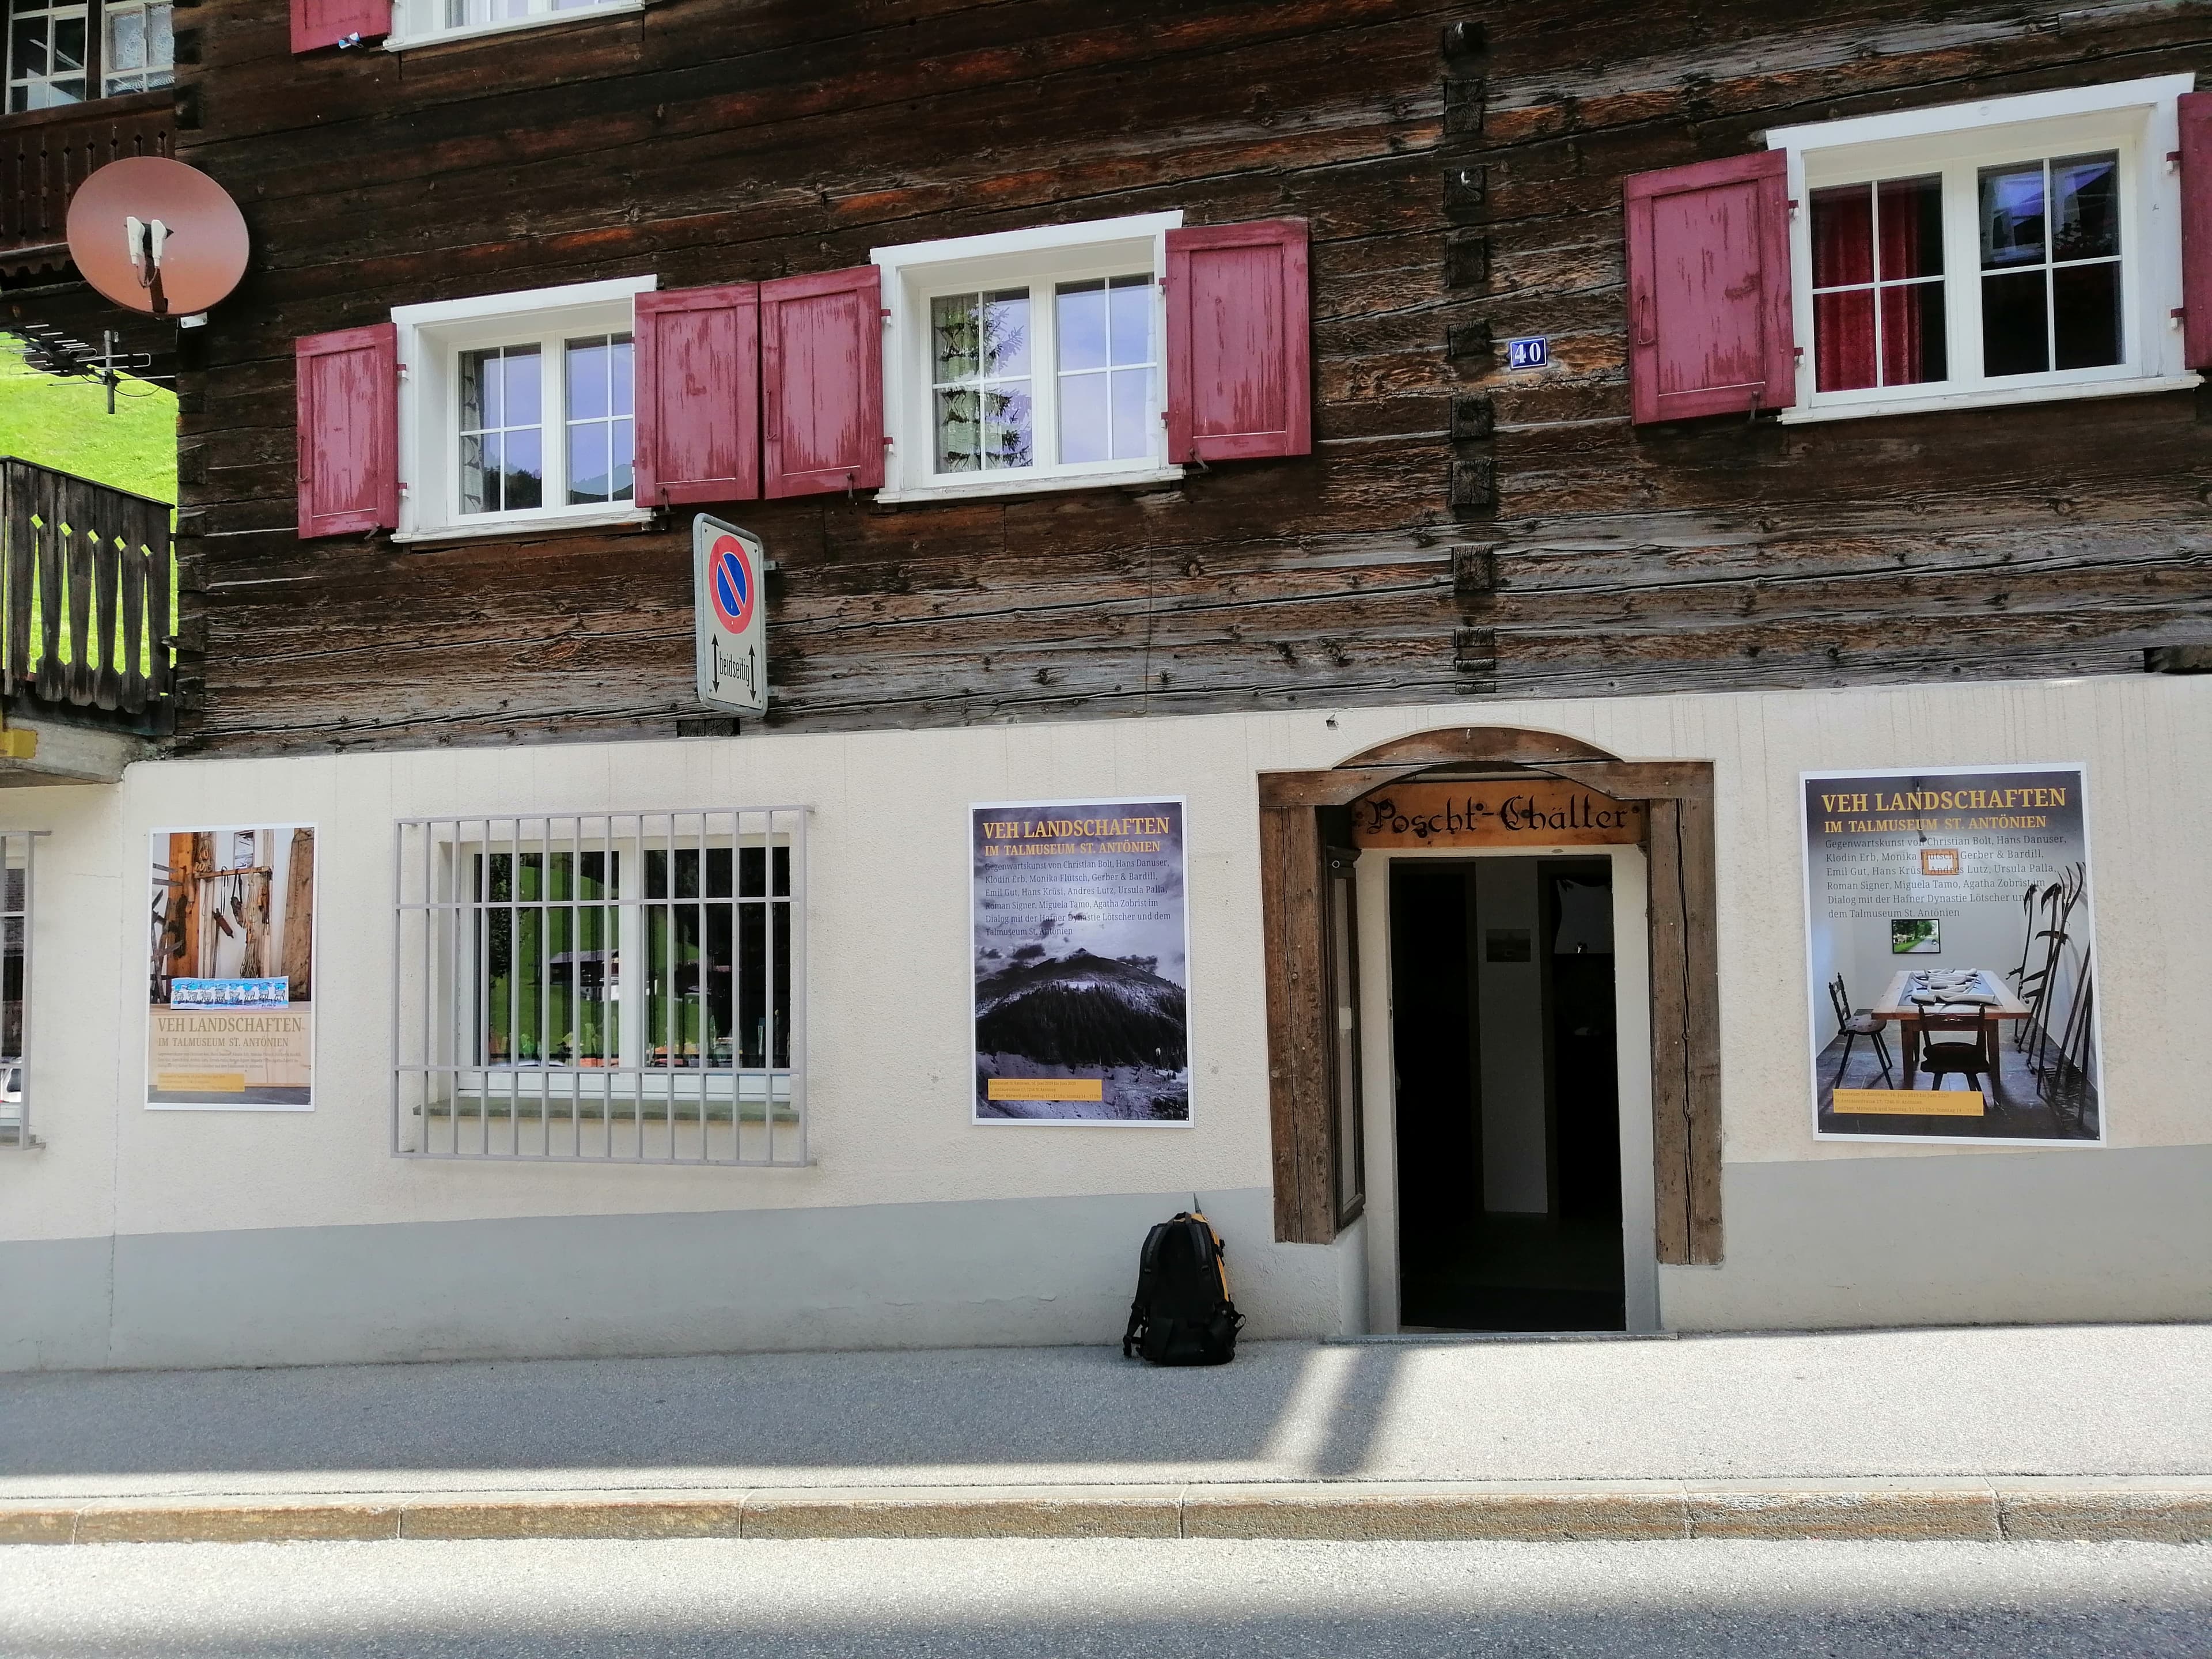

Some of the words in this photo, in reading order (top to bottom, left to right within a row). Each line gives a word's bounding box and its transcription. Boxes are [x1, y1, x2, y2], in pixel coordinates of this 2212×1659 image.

[1514, 342, 1541, 363] 40
[719, 650, 749, 687] beidseitig
[1821, 793, 1869, 813] VEH
[1874, 787, 2067, 811] LANDSCHAFTEN
[983, 821, 1019, 839] VEH
[1023, 817, 1170, 838] LANDSCHAFTEN
[1824, 820, 1842, 833] IM
[1848, 818, 1938, 832] TALMUSEUM
[1944, 817, 1965, 830] ST.
[1969, 813, 2047, 829] ANTÖNIEN
[984, 845, 999, 857] IM
[1004, 843, 1075, 856] TALMUSEUM
[1080, 842, 1096, 855] ST.
[1099, 839, 1161, 853] ANTÖNIEN
[1825, 838, 1904, 850] Gegenwartskunst
[1927, 836, 1970, 846] Christian
[1972, 836, 1994, 845] Bolt,
[1997, 835, 2021, 844] Hans
[2024, 835, 2067, 844] Danuser,
[1826, 853, 1857, 862] Klodin
[1859, 853, 1878, 862] Erb,
[1882, 852, 1917, 861] Monika
[1960, 850, 1994, 859] Gerber
[1997, 850, 2005, 858] &
[2008, 849, 2044, 858] Bardill,
[985, 861, 1046, 872] Gegenwartskunst
[1063, 859, 1096, 869] Christian
[1098, 859, 1114, 868] Bolt,
[1116, 859, 1135, 868] Hans
[1137, 859, 1170, 867] Danuser,
[1826, 866, 1847, 876] Emil
[1850, 867, 1869, 876] Gut,
[1872, 866, 1896, 876] Hans
[1930, 865, 1964, 874] Andres
[1967, 865, 1991, 874] Lutz,
[1994, 864, 2026, 873] Ursula
[986, 875, 1010, 884] Klodin
[1012, 874, 1028, 884] Erb,
[1029, 874, 1058, 883] Monika
[1092, 873, 1119, 881] Gerber
[1120, 872, 1126, 881] &
[1129, 872, 1158, 881] Bardill,
[1827, 881, 1858, 890] Roman
[1861, 881, 1892, 891] Signer,
[1894, 880, 1930, 891] Miguela
[1933, 880, 1960, 889] Tamo,
[1963, 879, 1995, 891] Agatha
[1998, 878, 2031, 888] Zobrist
[2032, 878, 2045, 887] im
[986, 888, 1002, 897] Emil
[1004, 888, 1020, 897] Gut,
[1022, 888, 1041, 896] Hans
[1067, 887, 1094, 895] Andres
[1097, 886, 1116, 895] Lutz,
[1118, 885, 1143, 893] Ursula
[1146, 885, 1167, 893] Palla,
[986, 902, 1010, 910] Roman
[1012, 901, 1037, 911] Signer,
[1039, 900, 1067, 910] Miguela
[1069, 900, 1092, 908] Tamo,
[1093, 899, 1119, 910] Agatha
[1120, 899, 1147, 907] Zobrist
[1149, 899, 1158, 907] im
[1828, 895, 1856, 906] Dialog
[1858, 895, 1872, 904] mit
[1875, 895, 1891, 904] der
[1893, 894, 1925, 903] Hafner
[1927, 894, 1967, 904] Dynastie
[1969, 893, 2010, 903] Lötscher
[2012, 893, 2029, 902] un
[986, 914, 1009, 924] Dialog
[1011, 914, 1022, 922] mit
[1025, 914, 1037, 922] der
[1040, 913, 1066, 922] Hafner
[1068, 912, 1100, 923] Dynastie
[1103, 912, 1135, 921] Lötscher
[1137, 912, 1152, 921] und
[1154, 911, 1171, 920] dem
[1828, 909, 1847, 918] dem
[1849, 908, 1902, 918] Talmuseum
[1904, 908, 1915, 917] St.
[1918, 907, 1960, 917] Antönien
[986, 927, 1027, 936] Talmuseum
[1029, 927, 1037, 935] St.
[158, 1017, 185, 1032] VEH
[189, 1017, 302, 1032] LANDSCHAFTEN
[158, 1037, 169, 1047] IM
[173, 1037, 225, 1047] TALMUSEUM
[229, 1037, 241, 1047] ST.
[244, 1036, 289, 1047] ANTÖNIEN
